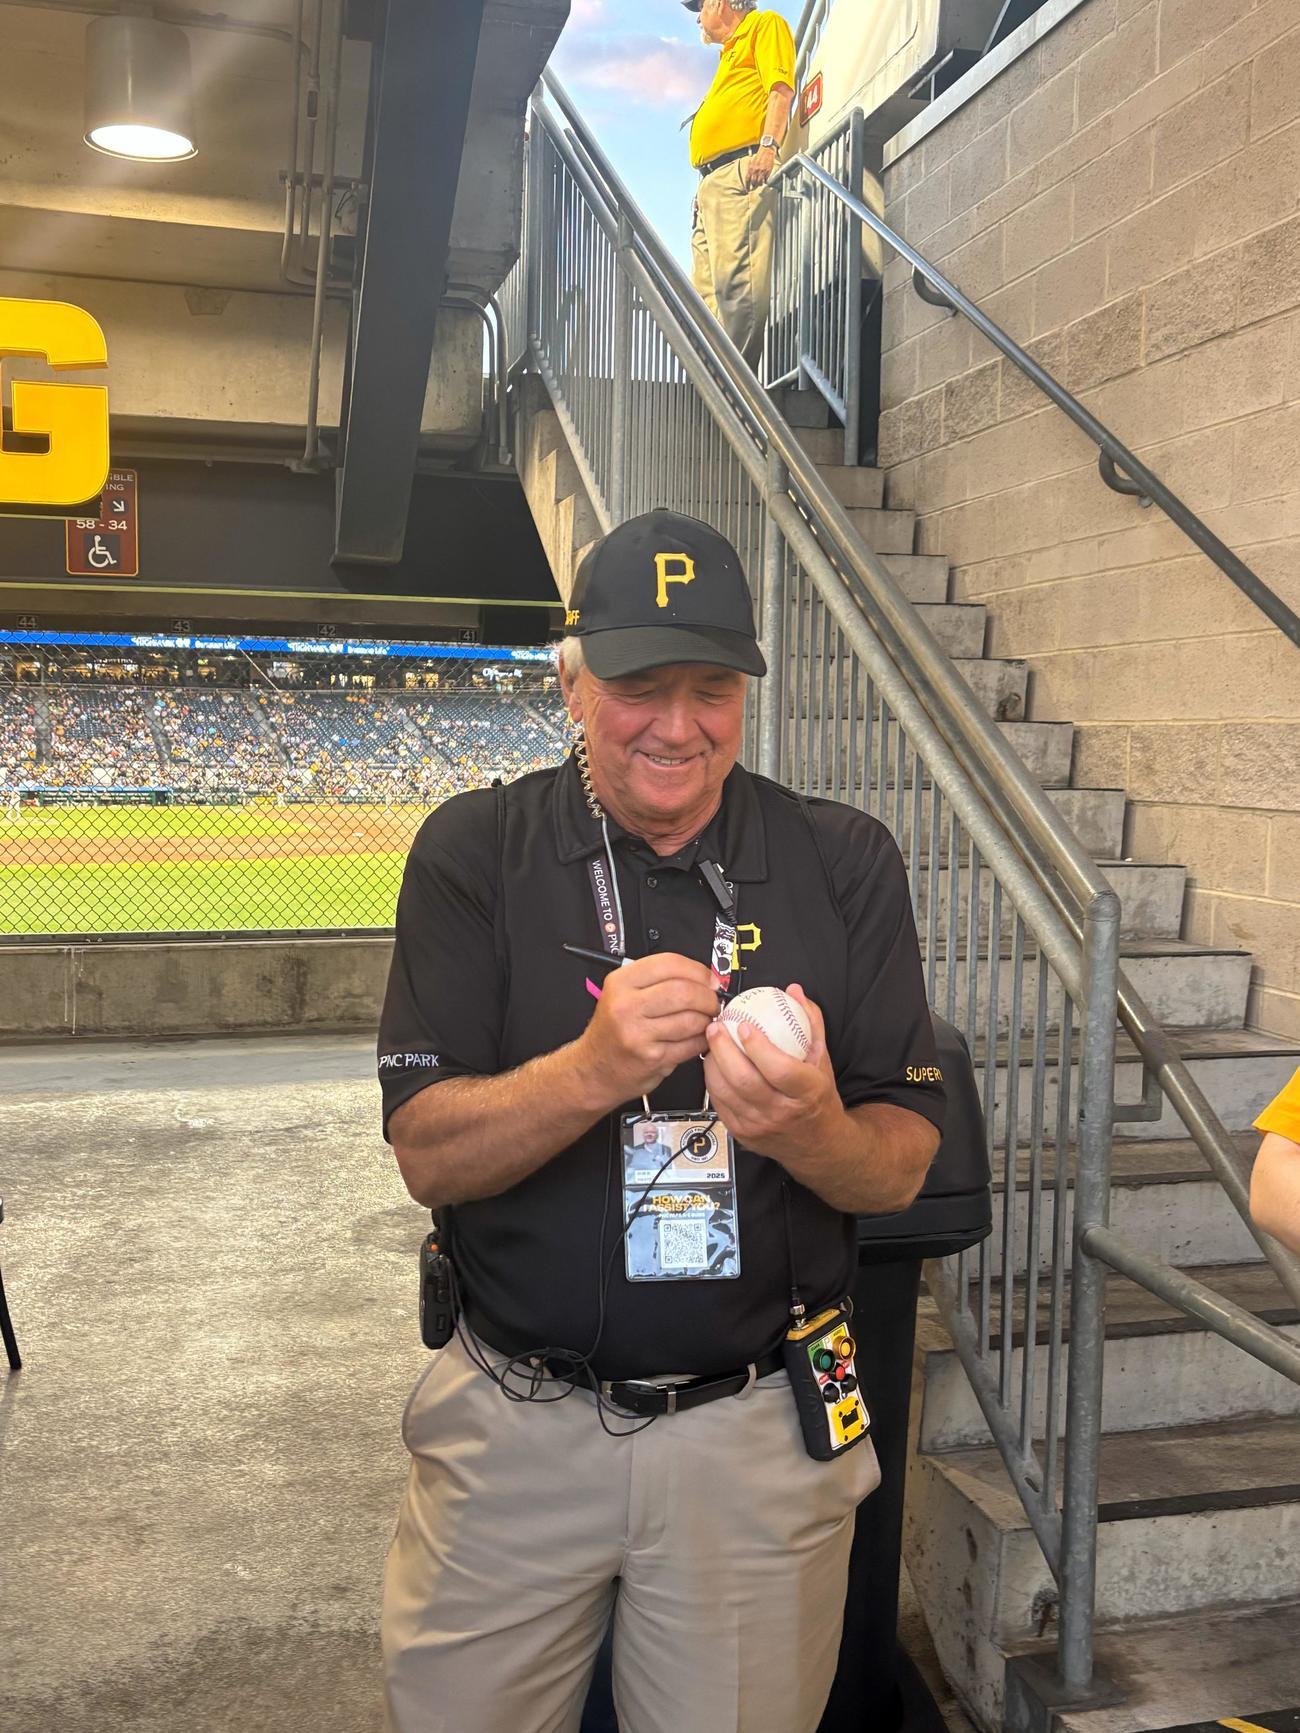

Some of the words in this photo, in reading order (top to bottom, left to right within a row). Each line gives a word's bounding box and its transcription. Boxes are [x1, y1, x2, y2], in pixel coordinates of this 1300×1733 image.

[0, 297, 110, 505] G
[106, 483, 125, 491] ING
[76, 520, 96, 529] 58
[108, 520, 128, 531] 34
[653, 552, 696, 608] P
[19, 616, 37, 627] 44
[319, 625, 336, 636] 42
[463, 630, 475, 640] 41
[592, 859, 611, 907] WELCOME
[602, 906, 613, 921] TO
[731, 922, 762, 971] P
[378, 1054, 403, 1068] PNC
[404, 1053, 440, 1068] PARK
[652, 1195, 680, 1204] HOW
[648, 1202, 690, 1212] ASSIST
